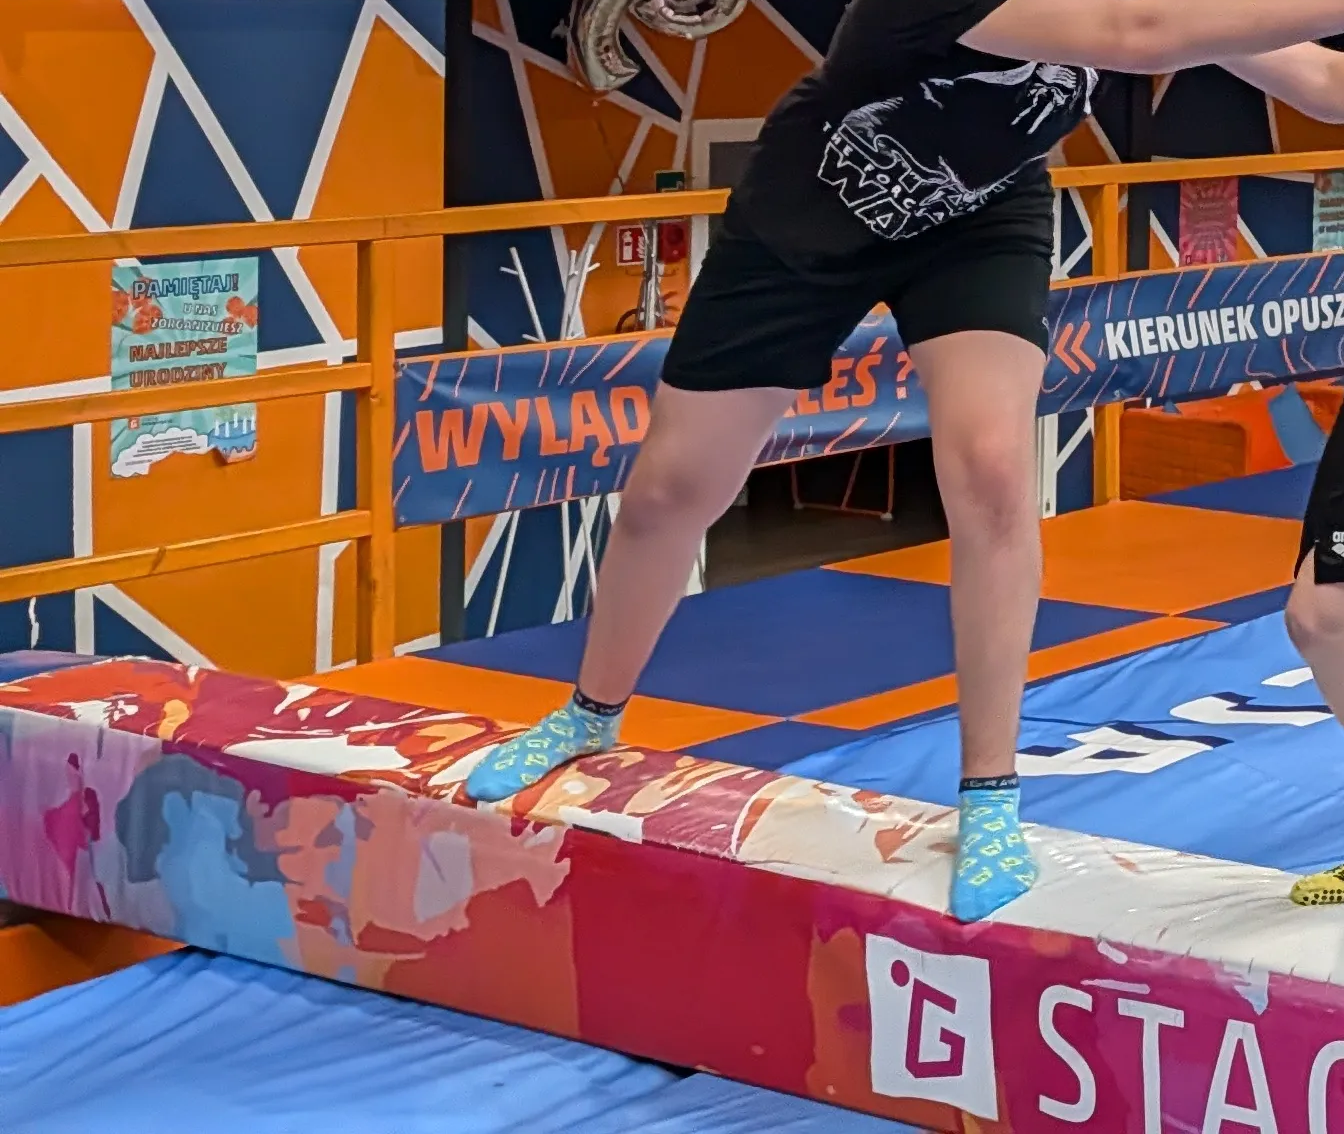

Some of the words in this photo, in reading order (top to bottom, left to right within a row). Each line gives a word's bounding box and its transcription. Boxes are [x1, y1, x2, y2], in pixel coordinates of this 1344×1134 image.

[864, 163, 918, 210] FORC
[133, 273, 239, 300] PAMIĘTAJ!
[195, 304, 218, 315] NAS
[151, 317, 244, 334] ZORGANIZUJESZ
[1104, 303, 1259, 361] KIERUNEK
[129, 336, 228, 362] NAJLEPSZE
[129, 361, 228, 387] URODZINY
